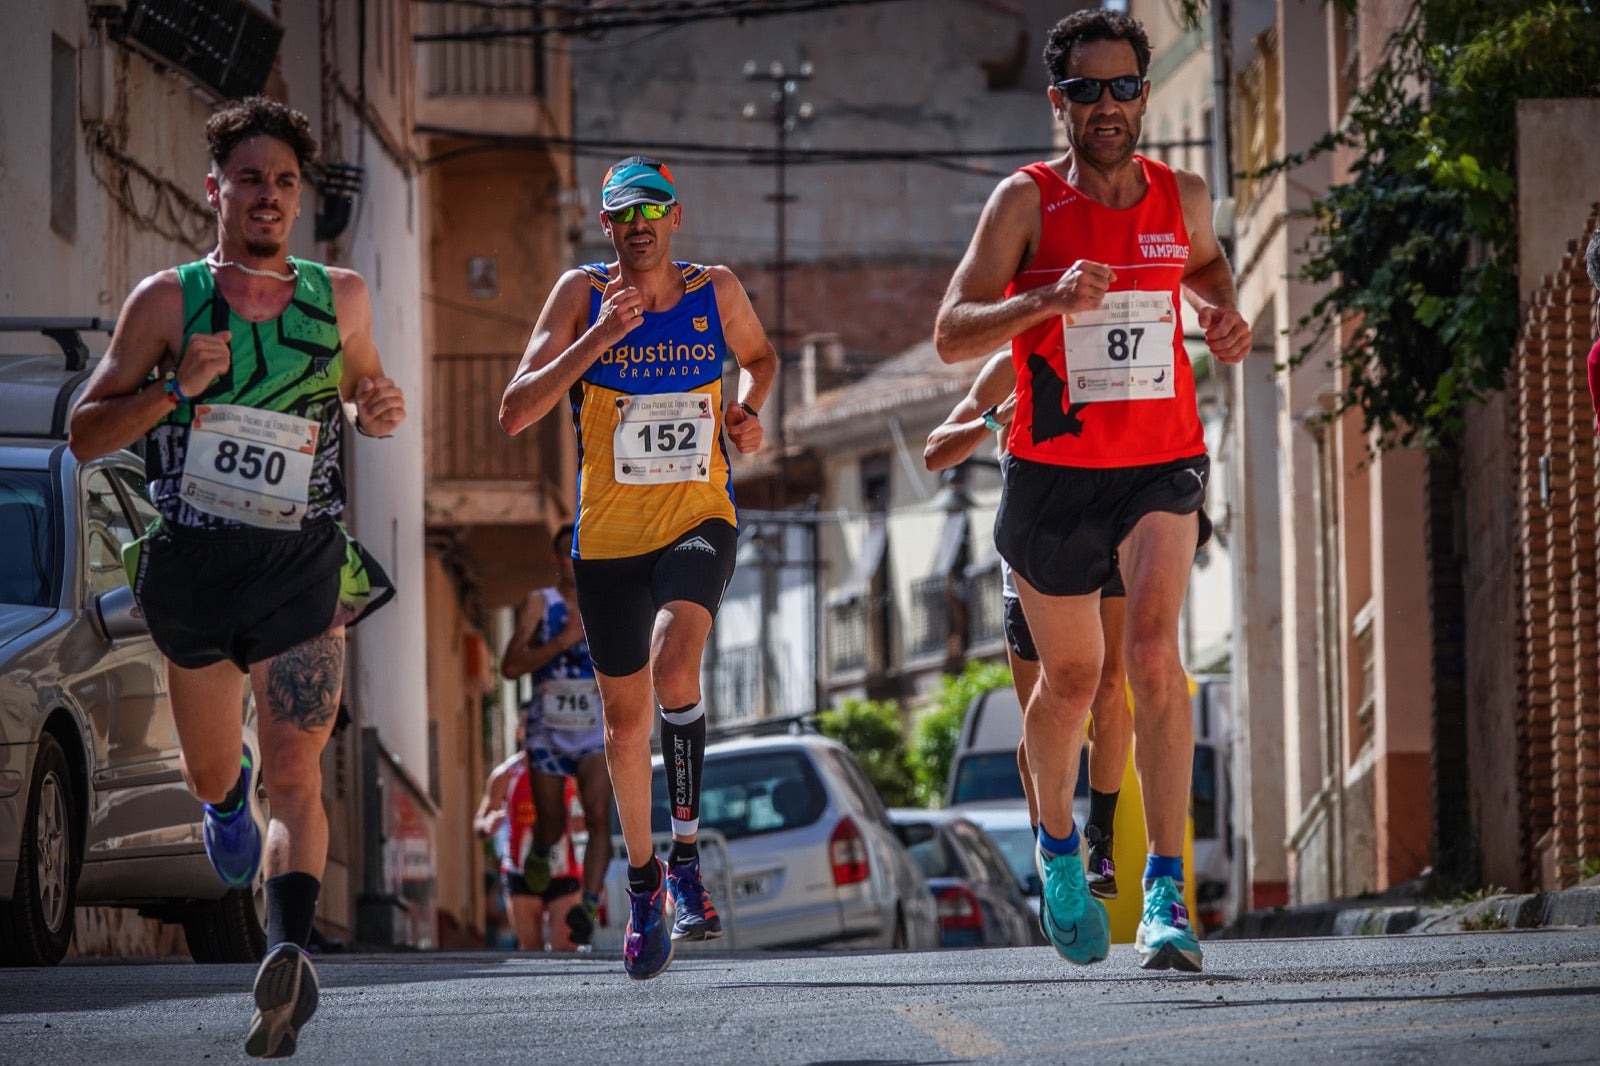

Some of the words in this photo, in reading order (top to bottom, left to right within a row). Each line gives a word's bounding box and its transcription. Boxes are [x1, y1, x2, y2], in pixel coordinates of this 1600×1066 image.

[1138, 233, 1176, 244] RUNNING
[1140, 244, 1190, 259] VAMPIROS
[600, 340, 716, 370] agustinos
[1107, 328, 1145, 361] 87
[619, 366, 700, 378] GRANADA
[637, 422, 697, 452] 152
[214, 440, 286, 485] 850
[555, 694, 589, 712] 716
